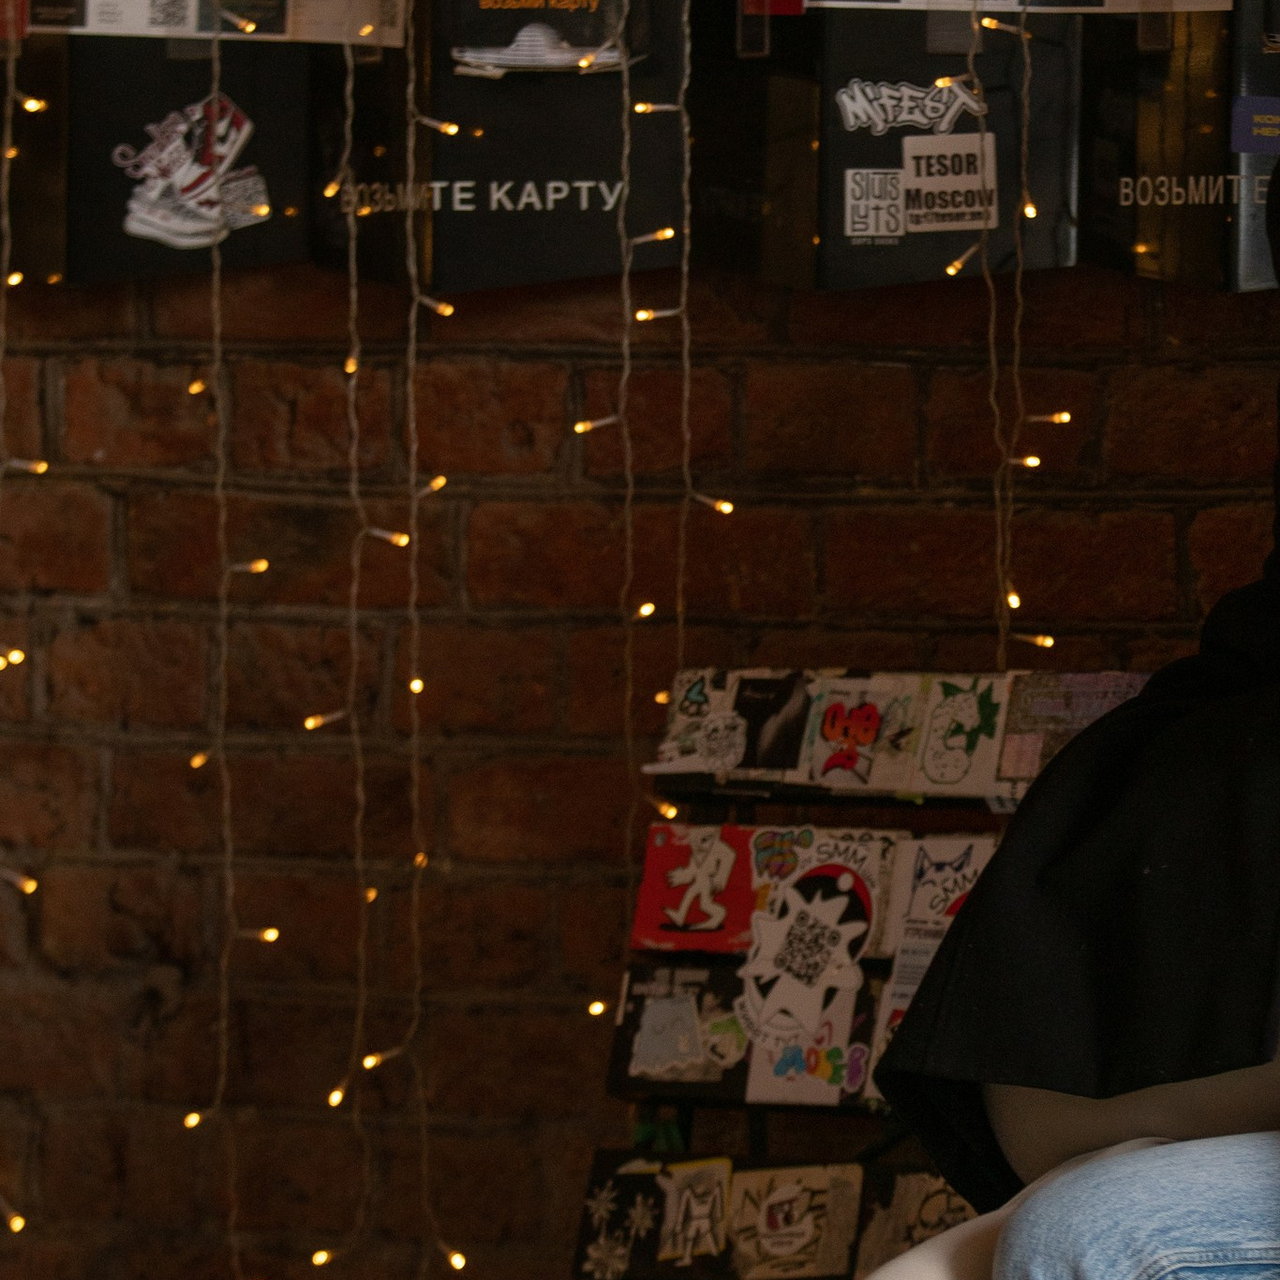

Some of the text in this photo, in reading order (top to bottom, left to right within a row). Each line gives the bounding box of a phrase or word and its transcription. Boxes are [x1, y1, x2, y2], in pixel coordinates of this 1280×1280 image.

[912, 153, 978, 178] TESOR
[489, 180, 624, 211] КАРТУ
[1118, 175, 1271, 206] ВОЗЬМИТЕ
